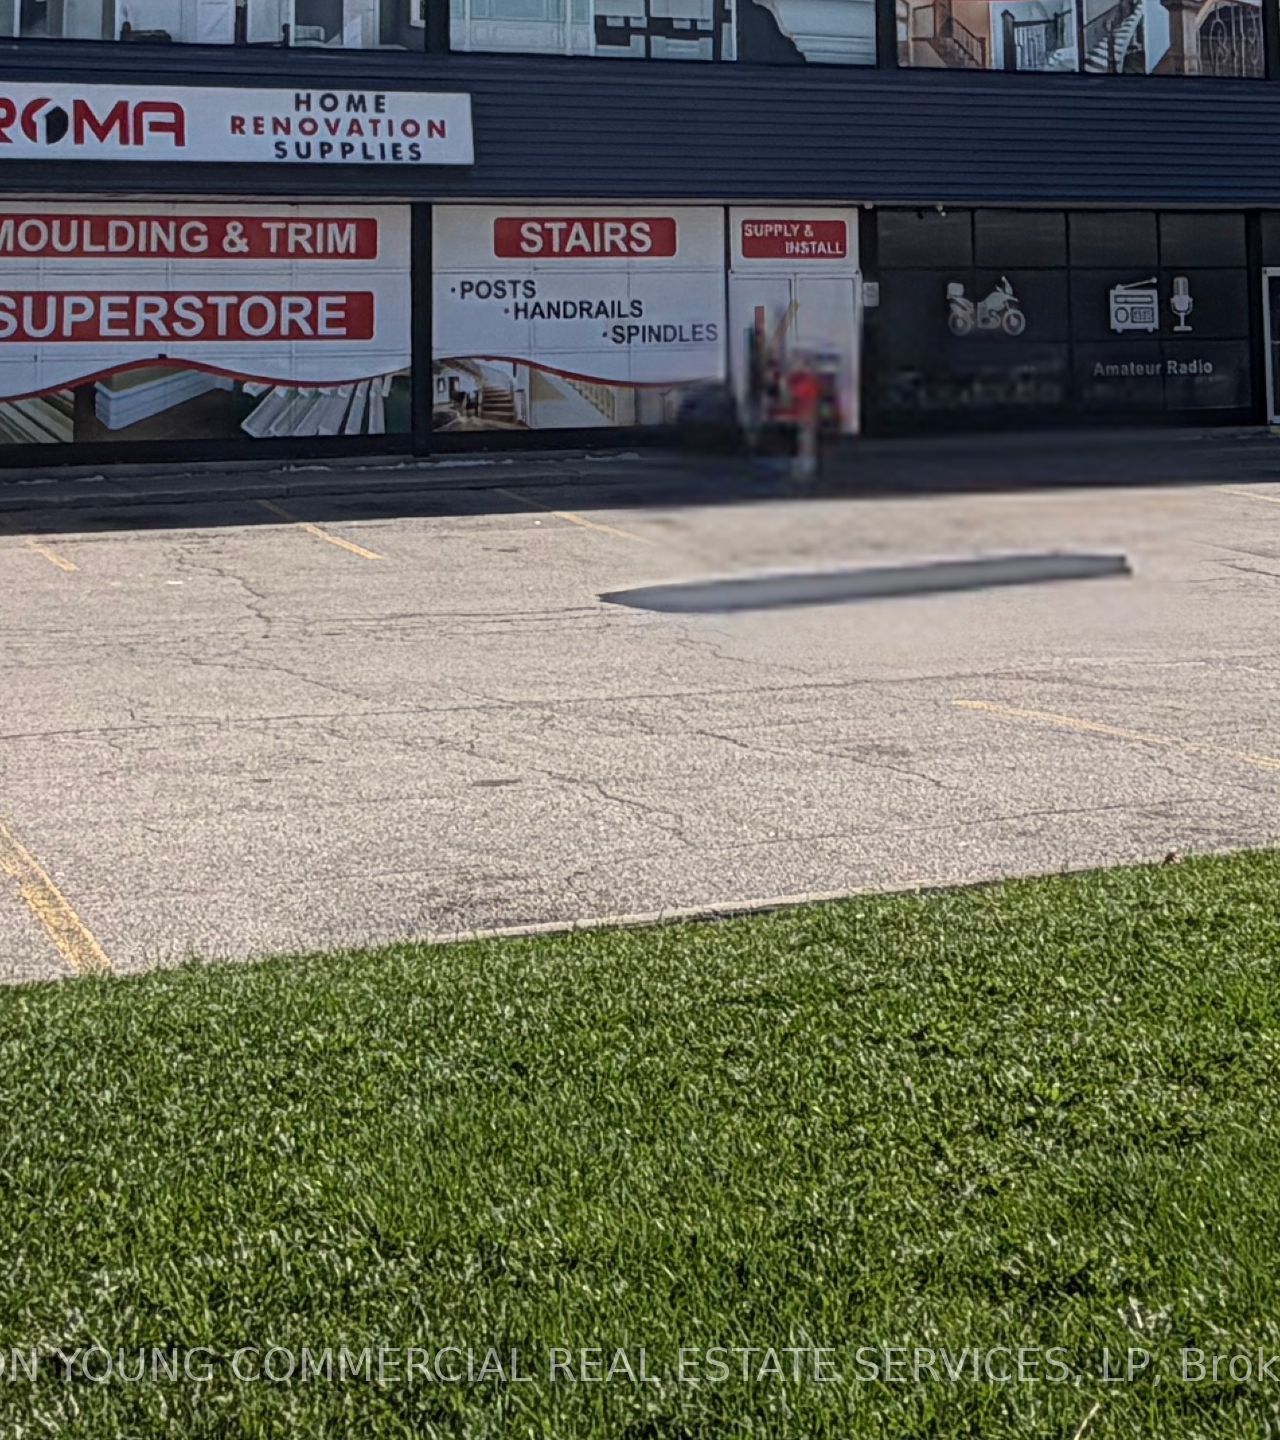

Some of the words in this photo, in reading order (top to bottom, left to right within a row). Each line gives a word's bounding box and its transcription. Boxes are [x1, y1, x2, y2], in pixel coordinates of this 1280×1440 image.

[294, 93, 386, 114] HOME
[230, 116, 448, 139] RENOVATION
[274, 141, 422, 161] SUPPLIES
[222, 222, 249, 253] &
[262, 222, 357, 254] TRIM
[519, 221, 653, 254] STAIRS
[744, 223, 800, 237] SUPPLY
[803, 224, 814, 237] &
[785, 241, 844, 254] INSTALL
[460, 280, 537, 300] POSTS
[514, 300, 644, 321] HANDRAILS
[611, 323, 719, 345] SPINDLES
[1093, 361, 1162, 377] Amateur
[1166, 359, 1213, 374] Radio
